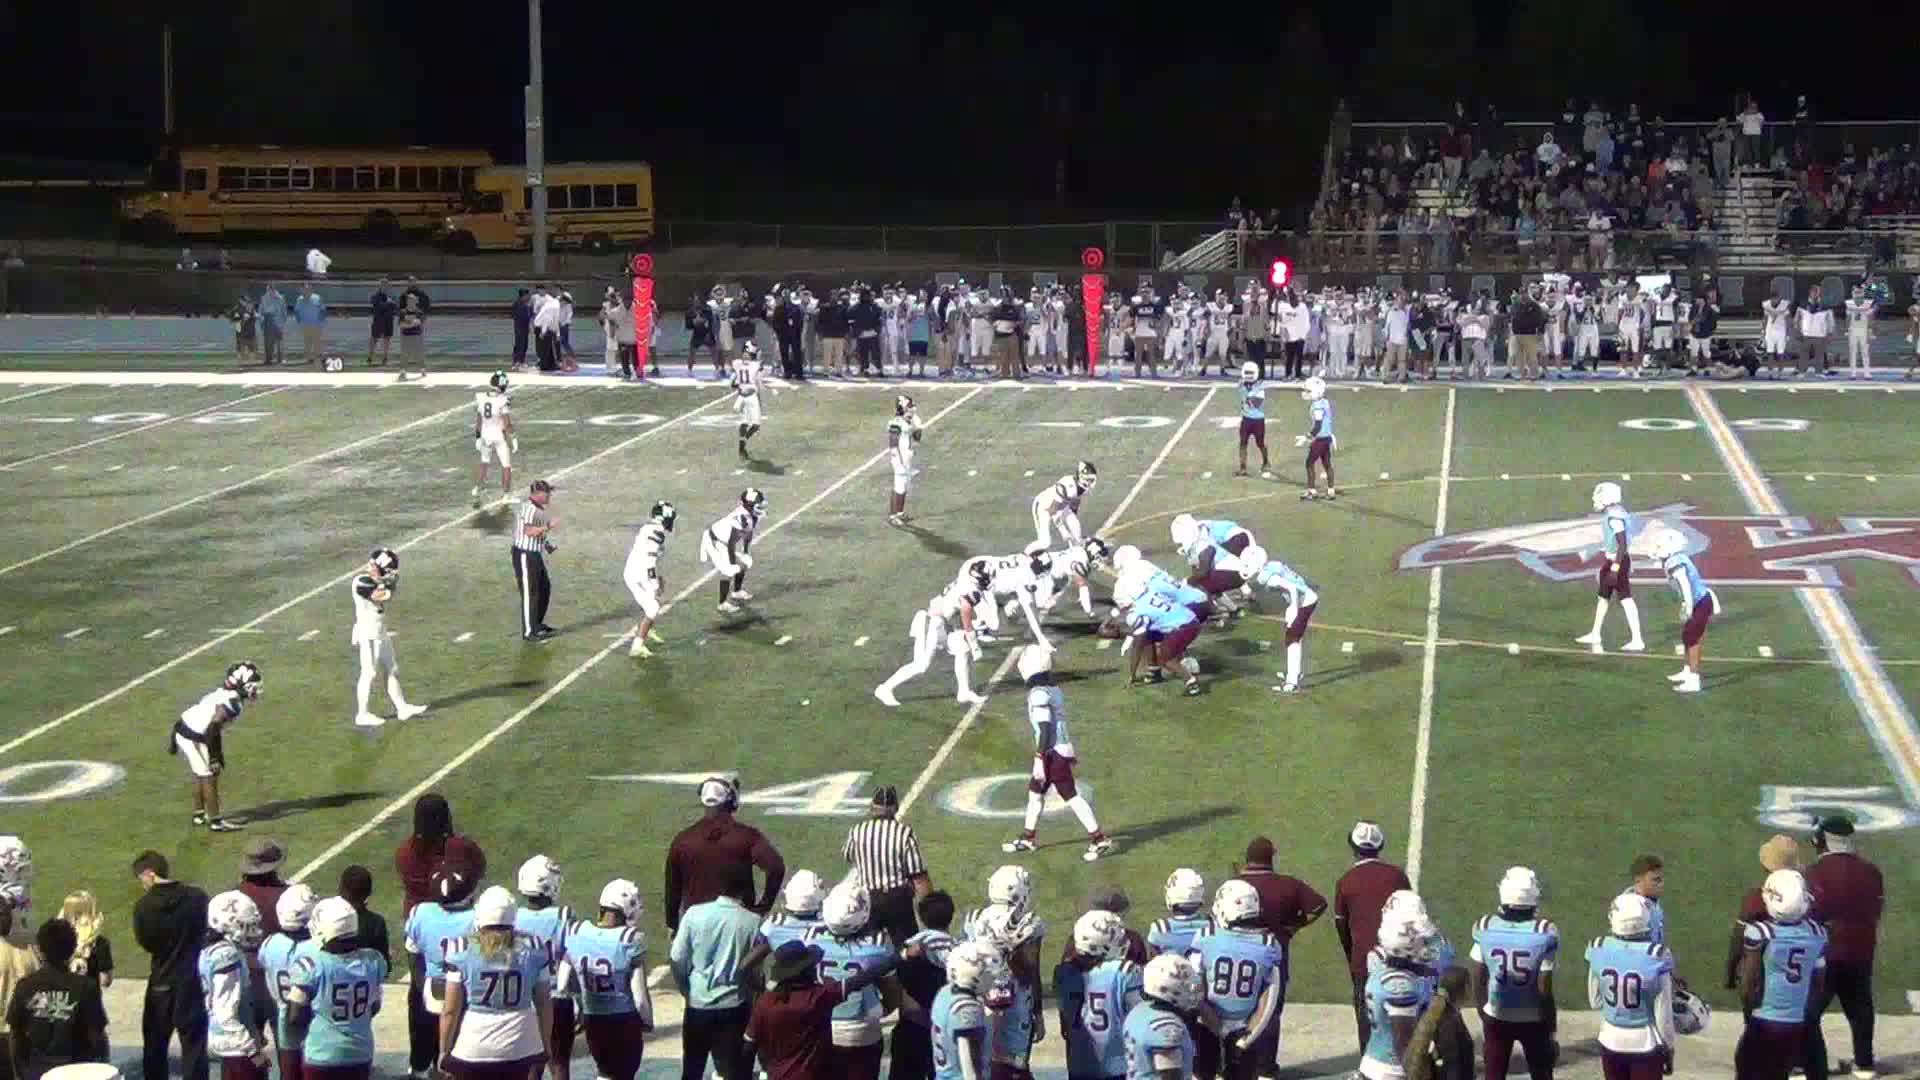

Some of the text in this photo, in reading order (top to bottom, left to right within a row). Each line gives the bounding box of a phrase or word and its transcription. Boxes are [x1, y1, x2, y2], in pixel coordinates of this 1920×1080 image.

[326, 357, 343, 371] 20
[739, 368, 750, 384] 11
[484, 401, 492, 419] 8
[580, 955, 614, 992] 12
[1213, 956, 1257, 998] 88
[1490, 947, 1531, 987] 35
[1785, 947, 1805, 984] 5
[331, 980, 369, 1022] 58
[479, 970, 522, 1007] 70
[1601, 967, 1642, 1009] 30
[1088, 991, 1109, 1031] 5
